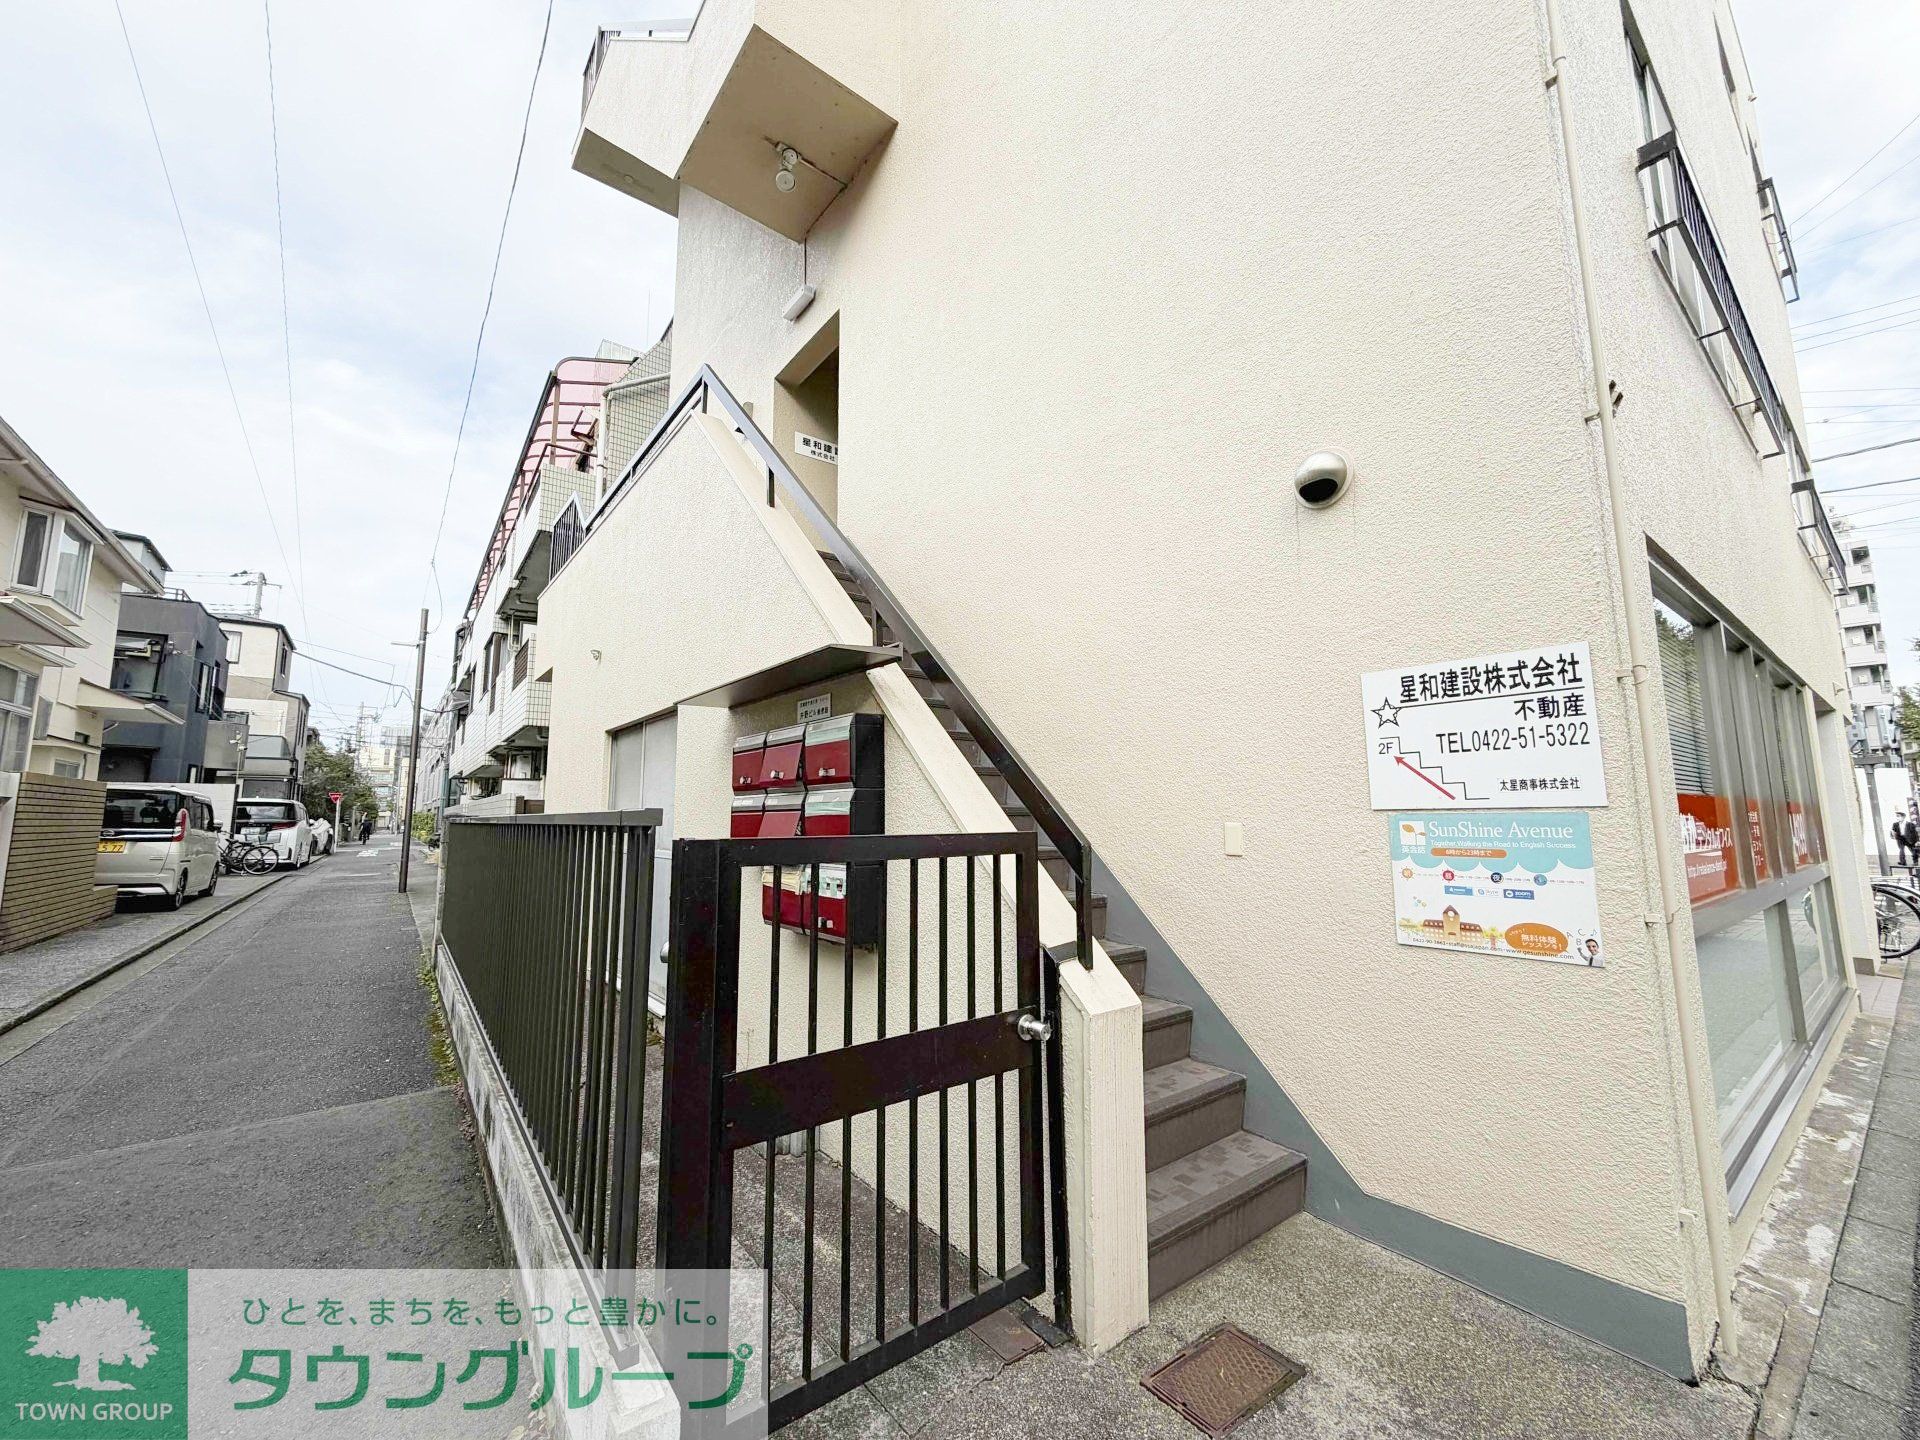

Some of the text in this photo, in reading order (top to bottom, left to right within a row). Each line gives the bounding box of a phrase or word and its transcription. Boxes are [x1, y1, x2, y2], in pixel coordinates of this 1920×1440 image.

[1400, 652, 1583, 703] 星和建設株式会社
[1514, 692, 1586, 721] 不動産
[1436, 721, 1590, 754] TEL0422-51-5322
[1378, 742, 1394, 755] 2F
[1499, 776, 1580, 792] 太星商事株式会社
[1428, 821, 1574, 838] SunShine Avenue
[1521, 933, 1557, 944] 無料体験
